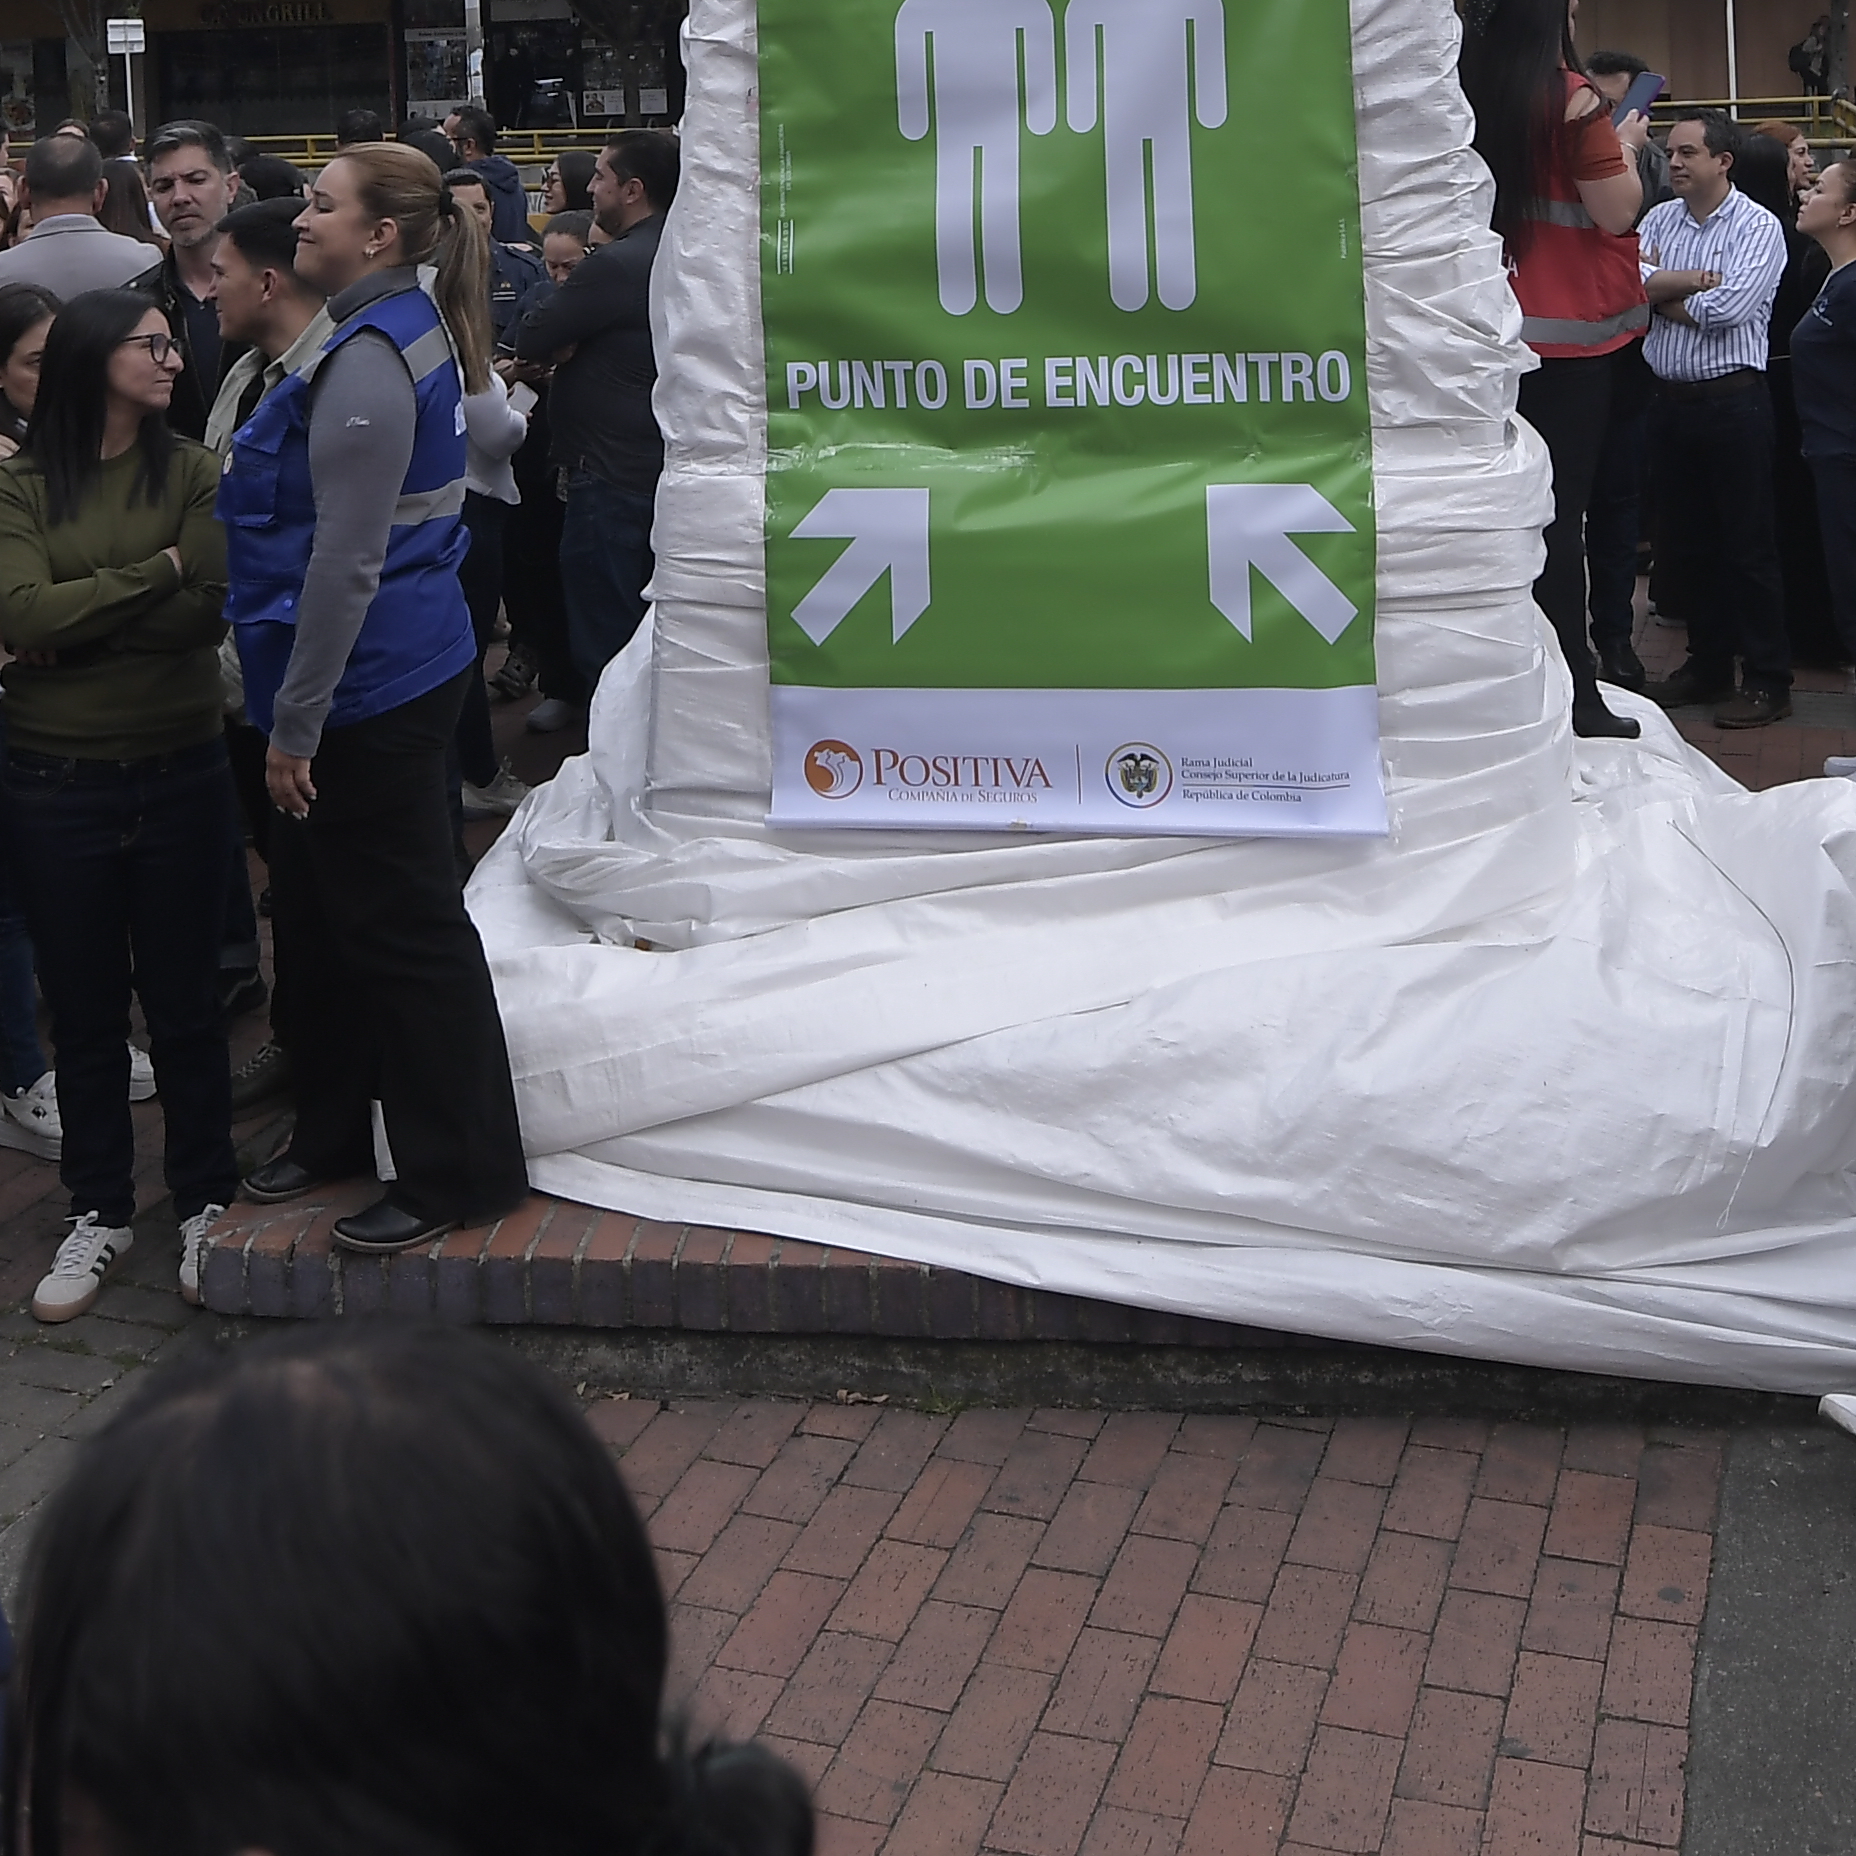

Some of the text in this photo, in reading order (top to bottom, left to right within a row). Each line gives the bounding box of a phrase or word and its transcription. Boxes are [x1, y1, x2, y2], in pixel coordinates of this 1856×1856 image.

[786, 349, 1351, 410] PUNTO DE ENCUENTRO
[871, 748, 1053, 789] POSITIVA
[1181, 757, 1253, 769] Rama Judicial
[1181, 769, 1350, 784] Consejo Superior de la Judicatura
[977, 789, 1038, 804] SEGUROS
[1182, 789, 1302, 803] República de Colombia
